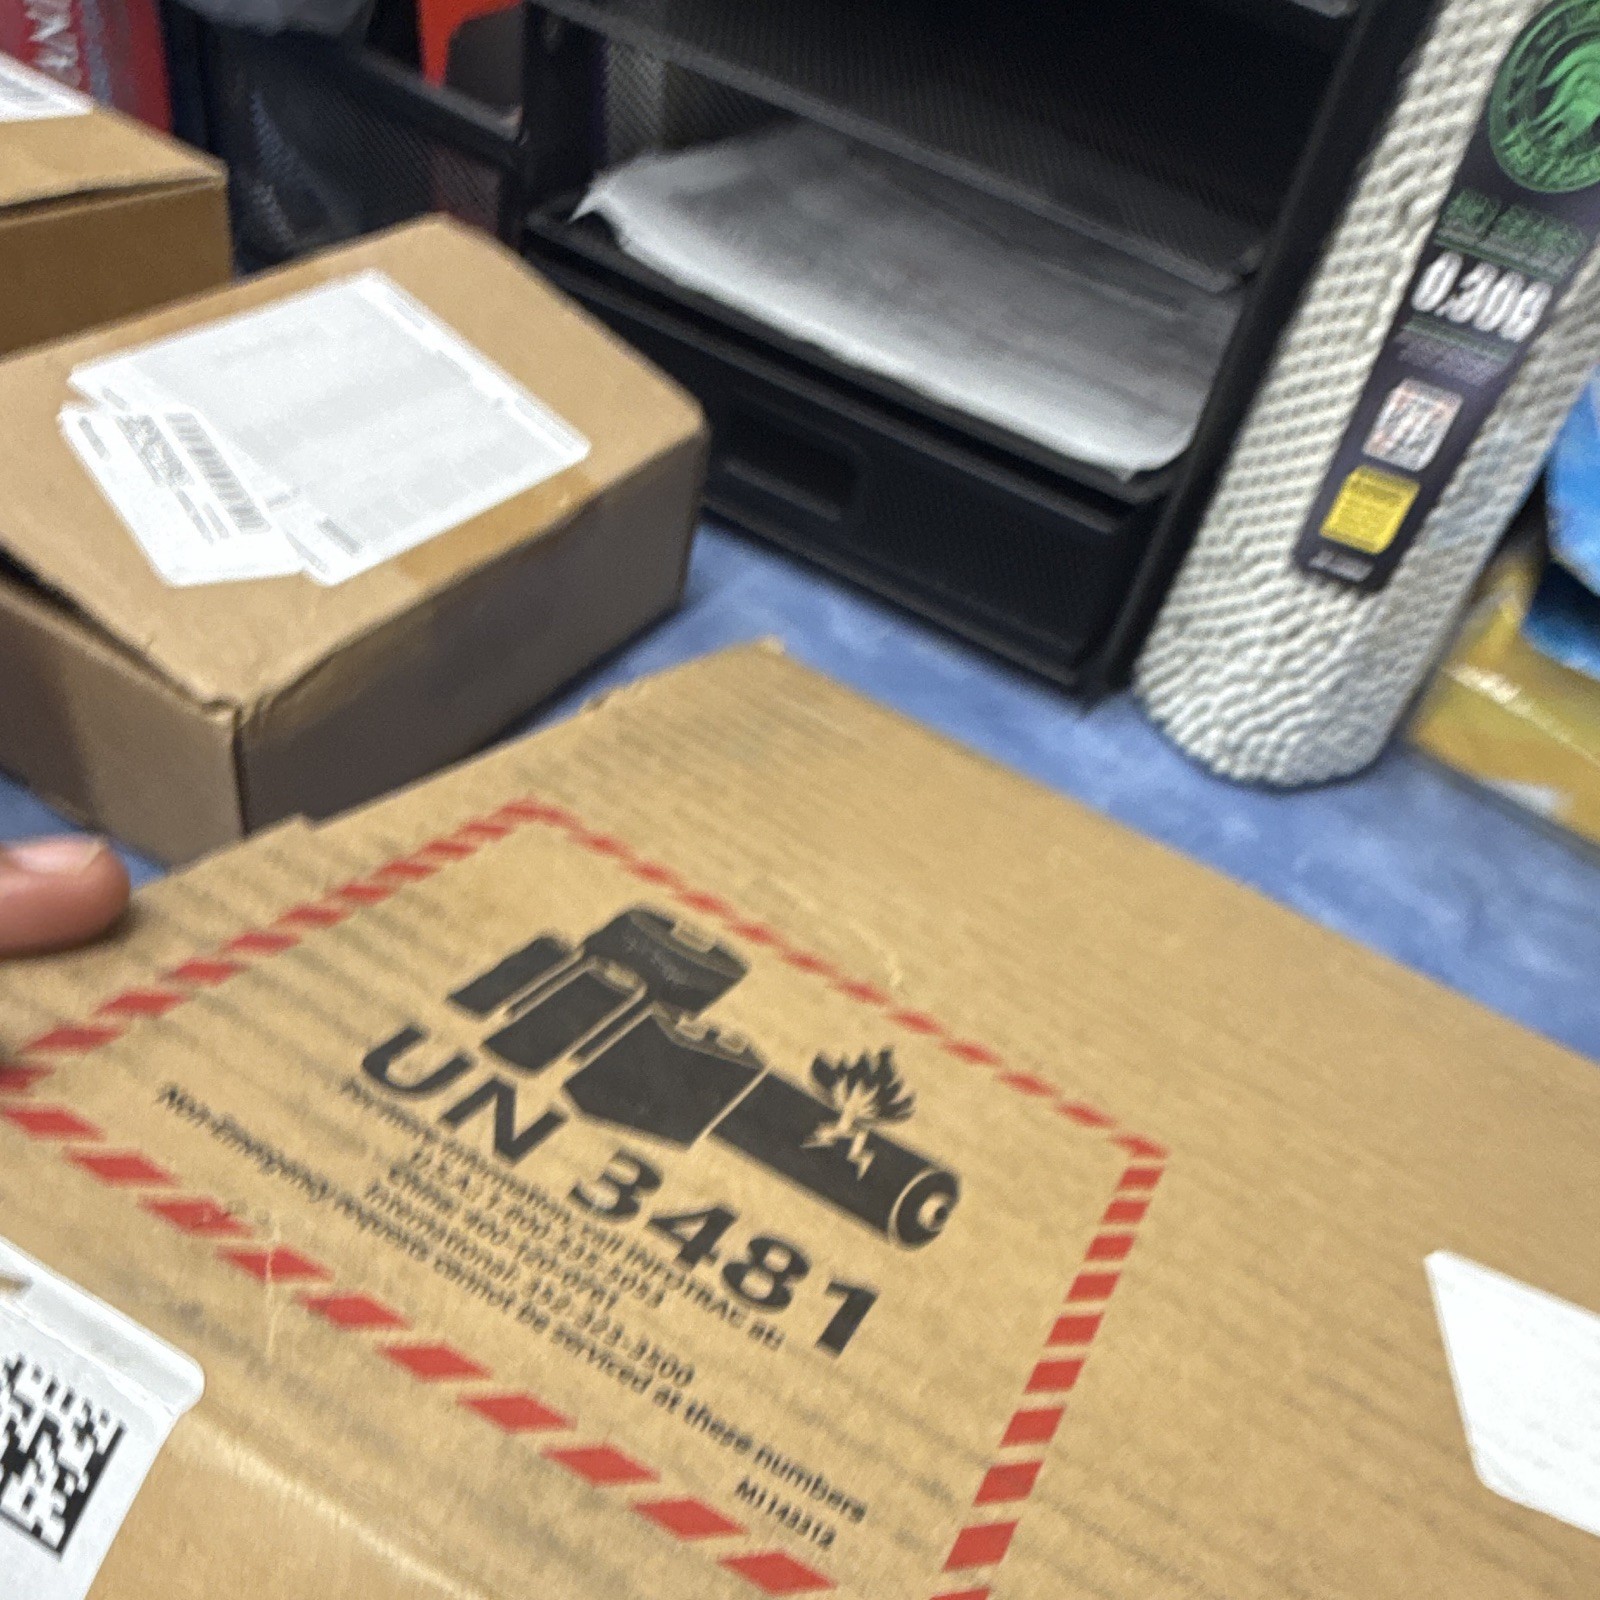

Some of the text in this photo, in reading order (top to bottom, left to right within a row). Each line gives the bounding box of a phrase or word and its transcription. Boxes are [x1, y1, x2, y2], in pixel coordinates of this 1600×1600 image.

[362, 1024, 878, 1357] UN 3481
[576, 1217, 628, 1254] call
[433, 1250, 521, 1313] cannot
[513, 1300, 557, 1334] be
[547, 1319, 657, 1396] serviced
[649, 1382, 687, 1415] at
[679, 1397, 758, 1458] these
[750, 1440, 871, 1529] numbers
